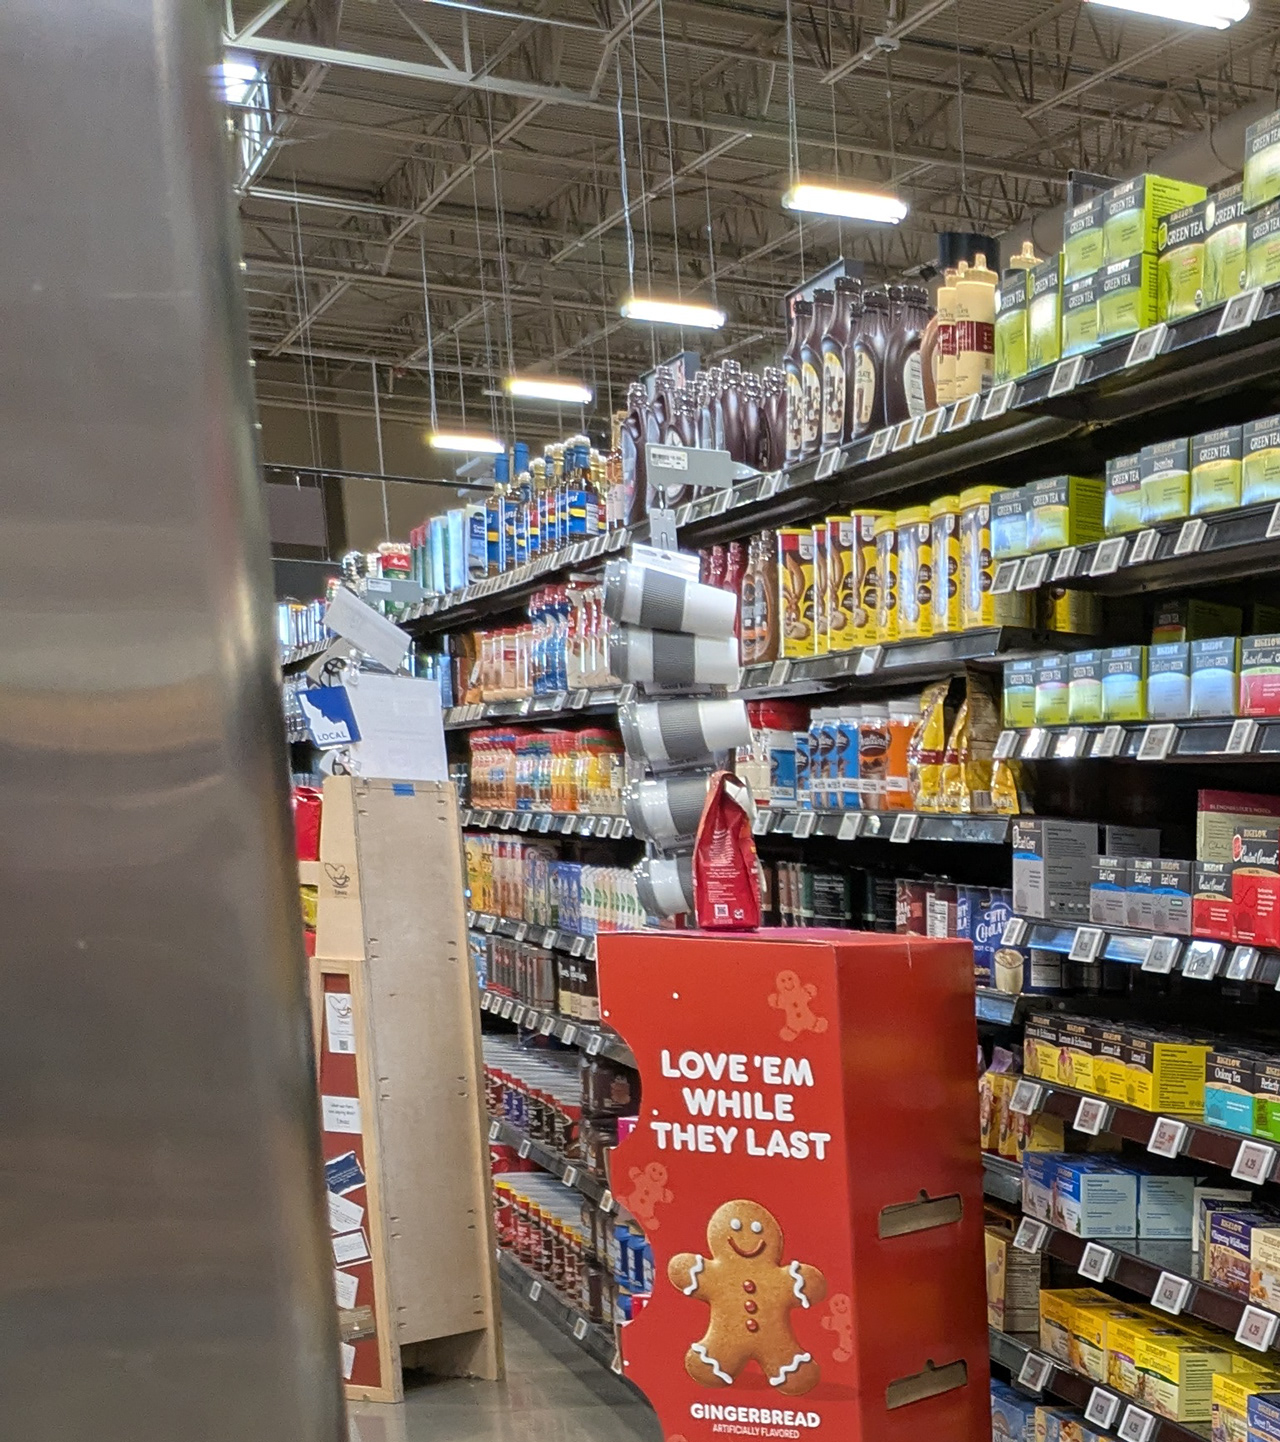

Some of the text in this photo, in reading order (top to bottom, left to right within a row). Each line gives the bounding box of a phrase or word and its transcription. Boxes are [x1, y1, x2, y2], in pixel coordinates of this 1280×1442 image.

[317, 731, 347, 741] LOCAL
[662, 1049, 815, 1086] LOVE 'EM
[682, 1088, 795, 1121] WHILE
[651, 1122, 832, 1160] THEY LAST
[690, 1402, 822, 1428] GINGERBREAD
[712, 1423, 800, 1440] ARTIFICIALLY FLAVORED
